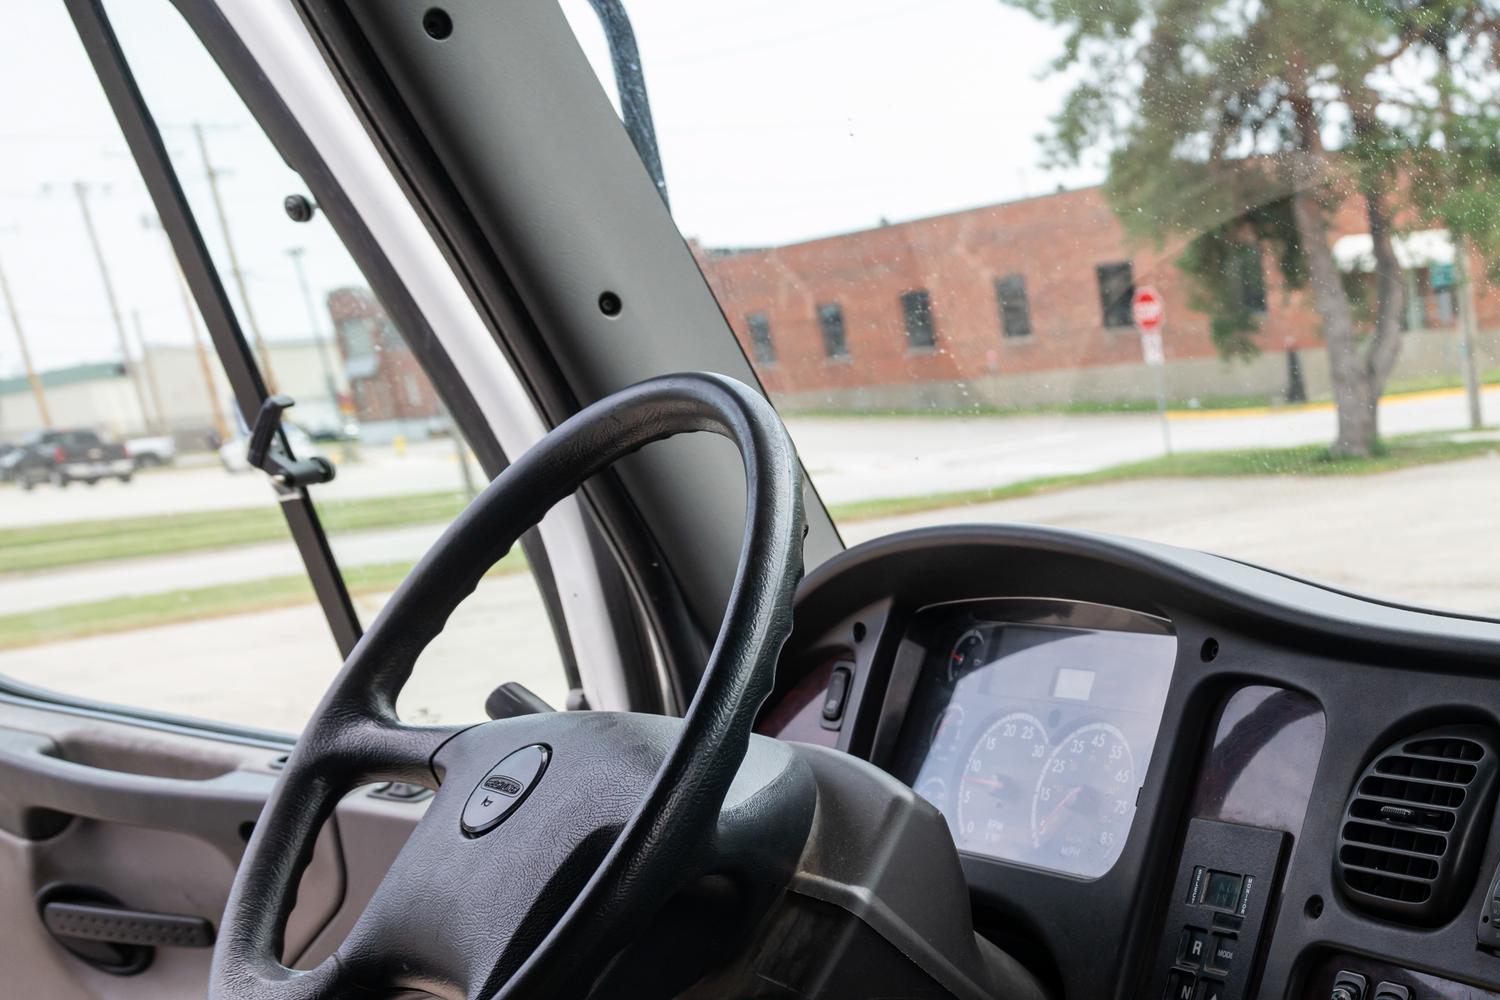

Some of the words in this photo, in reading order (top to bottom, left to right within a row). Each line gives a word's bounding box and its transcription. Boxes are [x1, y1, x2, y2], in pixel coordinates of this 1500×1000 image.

[1240, 878, 1253, 915] MONITOR
[1192, 940, 1203, 956] R
[1180, 985, 1191, 998] N
